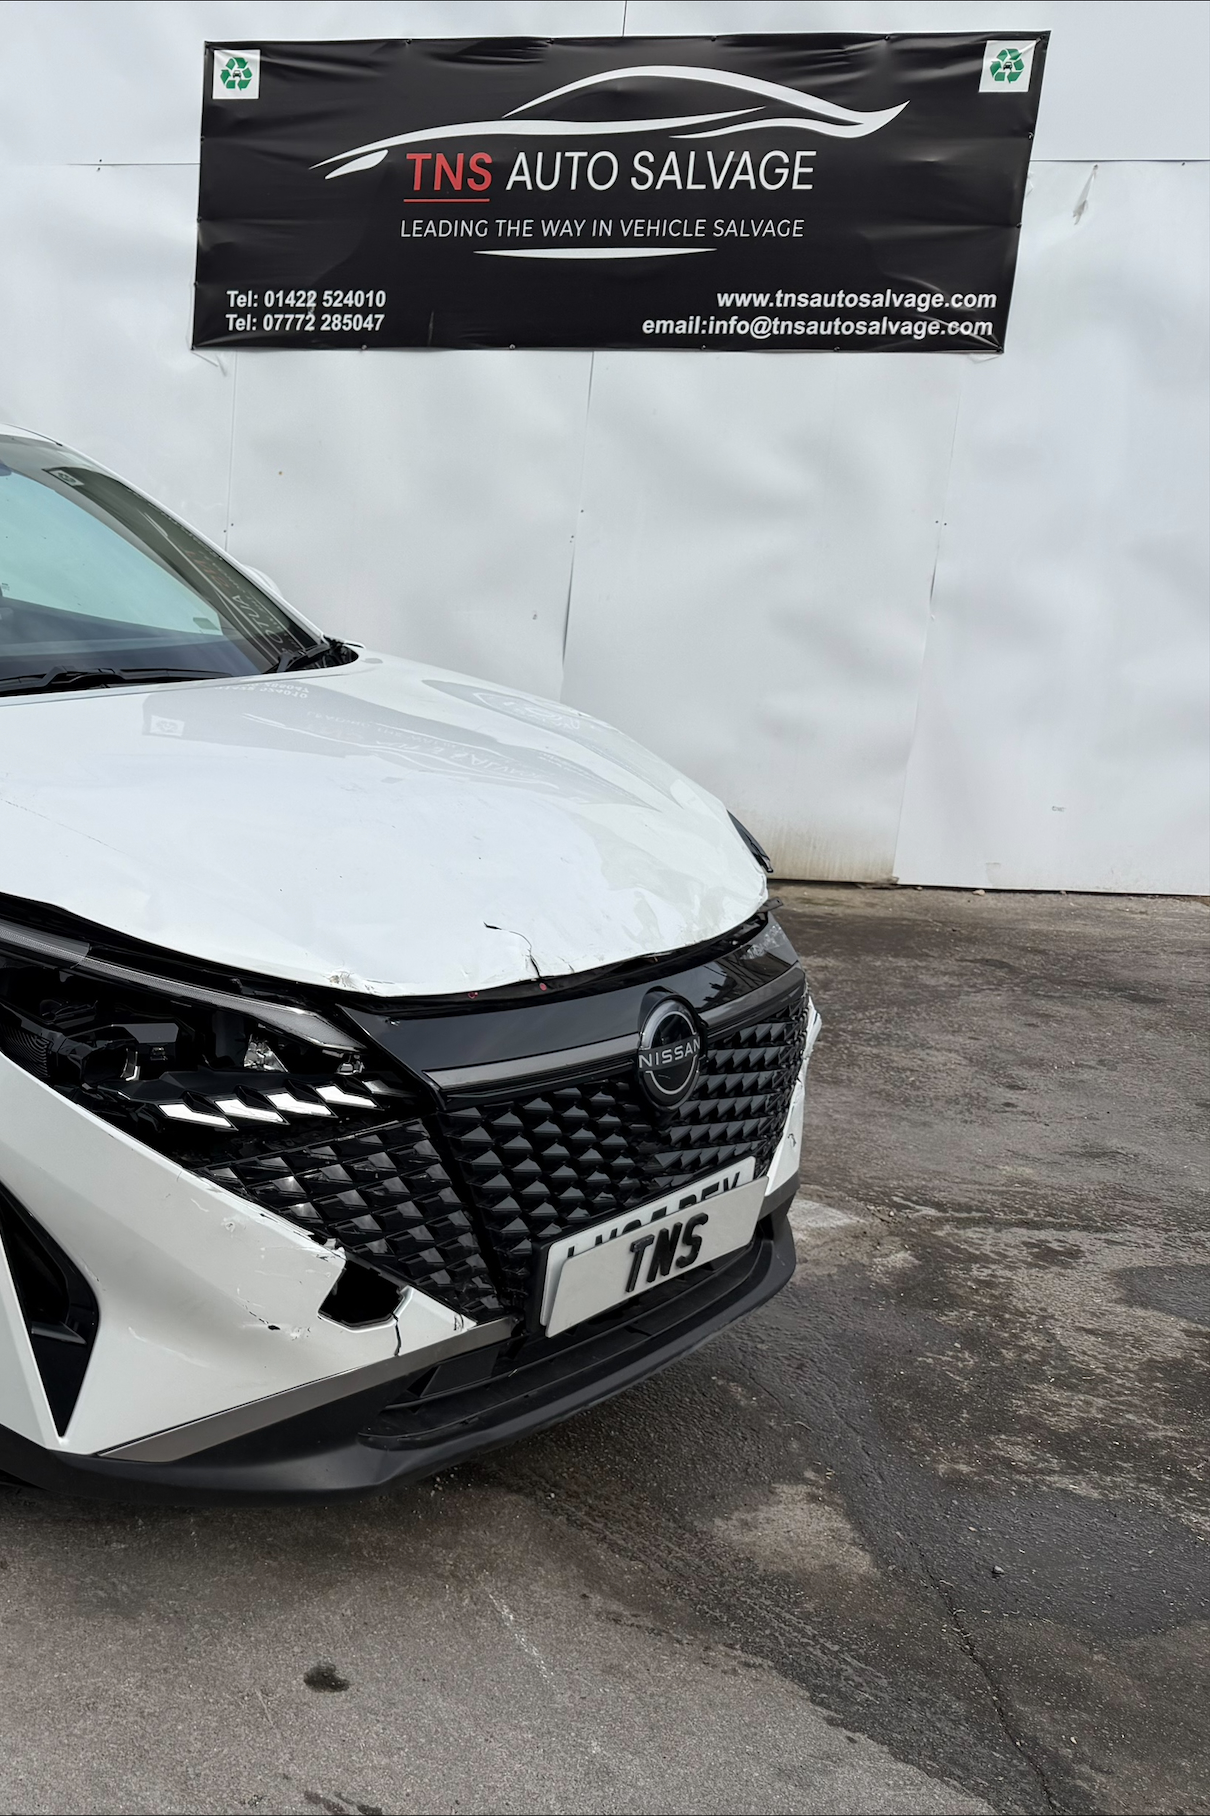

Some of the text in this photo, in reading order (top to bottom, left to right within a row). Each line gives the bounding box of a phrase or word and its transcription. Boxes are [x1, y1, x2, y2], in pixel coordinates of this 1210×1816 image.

[407, 151, 816, 190] TNS AUTO SALVAGE
[401, 220, 804, 237] LEADING THE WAY IN VEHICLE SALVAGE
[227, 291, 385, 308] Tel: 01422 524010
[717, 289, 996, 312] www.tnsautosalvage.com
[226, 314, 384, 331] Tel: 07772 285047
[642, 315, 993, 339] email:info@tnsautosalvage.com
[639, 1037, 701, 1069] NISSAN
[625, 1212, 709, 1293] TNS
